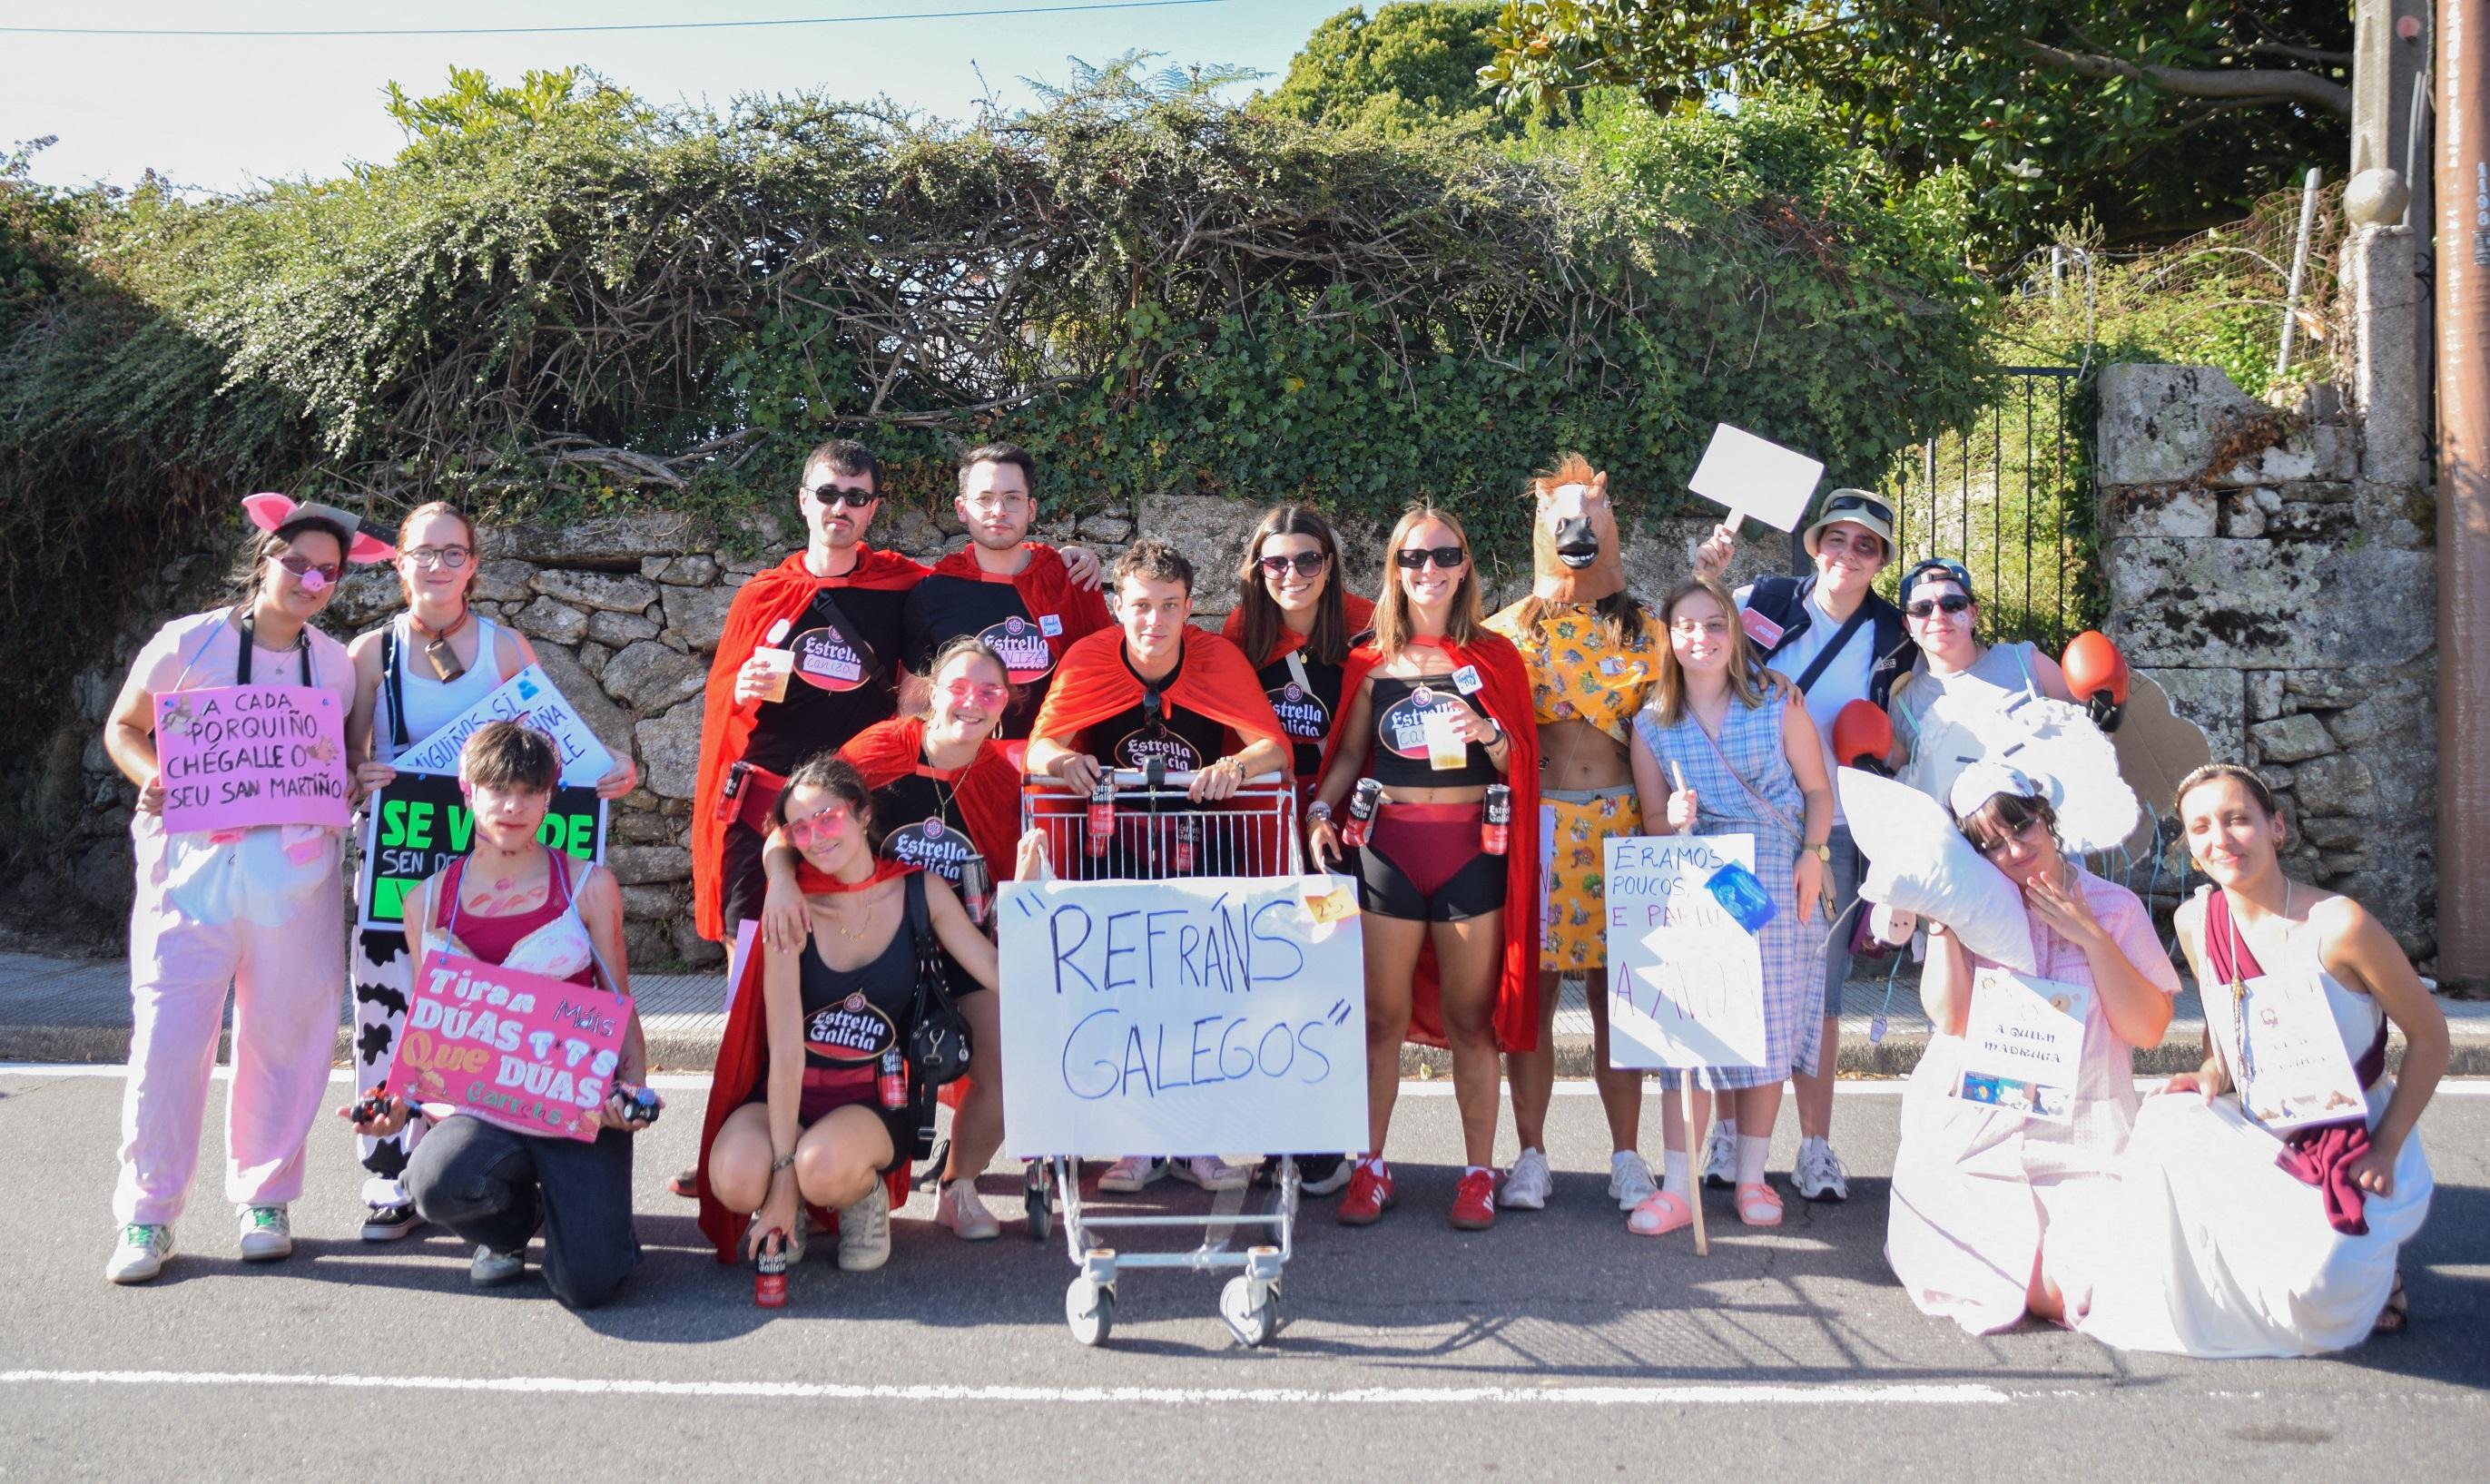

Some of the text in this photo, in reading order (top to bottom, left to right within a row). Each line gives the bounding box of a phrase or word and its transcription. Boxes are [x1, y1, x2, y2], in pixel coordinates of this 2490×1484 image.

[202, 693, 292, 717] A CADA
[1271, 700, 1322, 722] strella
[290, 743, 307, 768] O
[1127, 739, 1191, 759] Estrella
[169, 784, 211, 810] SEU
[220, 779, 260, 804] SAN
[381, 800, 435, 849] SE
[894, 833, 969, 861] Estrella
[1614, 840, 1726, 870] ÉRAMOS
[381, 849, 424, 875] SEN
[1612, 907, 1629, 927] E
[429, 968, 536, 1013] Tiran
[409, 998, 524, 1052] DÚAS
[810, 1023, 876, 1051] Galicia
[812, 1010, 885, 1037] Estrella
[402, 1031, 603, 1109] Que DÚAS
